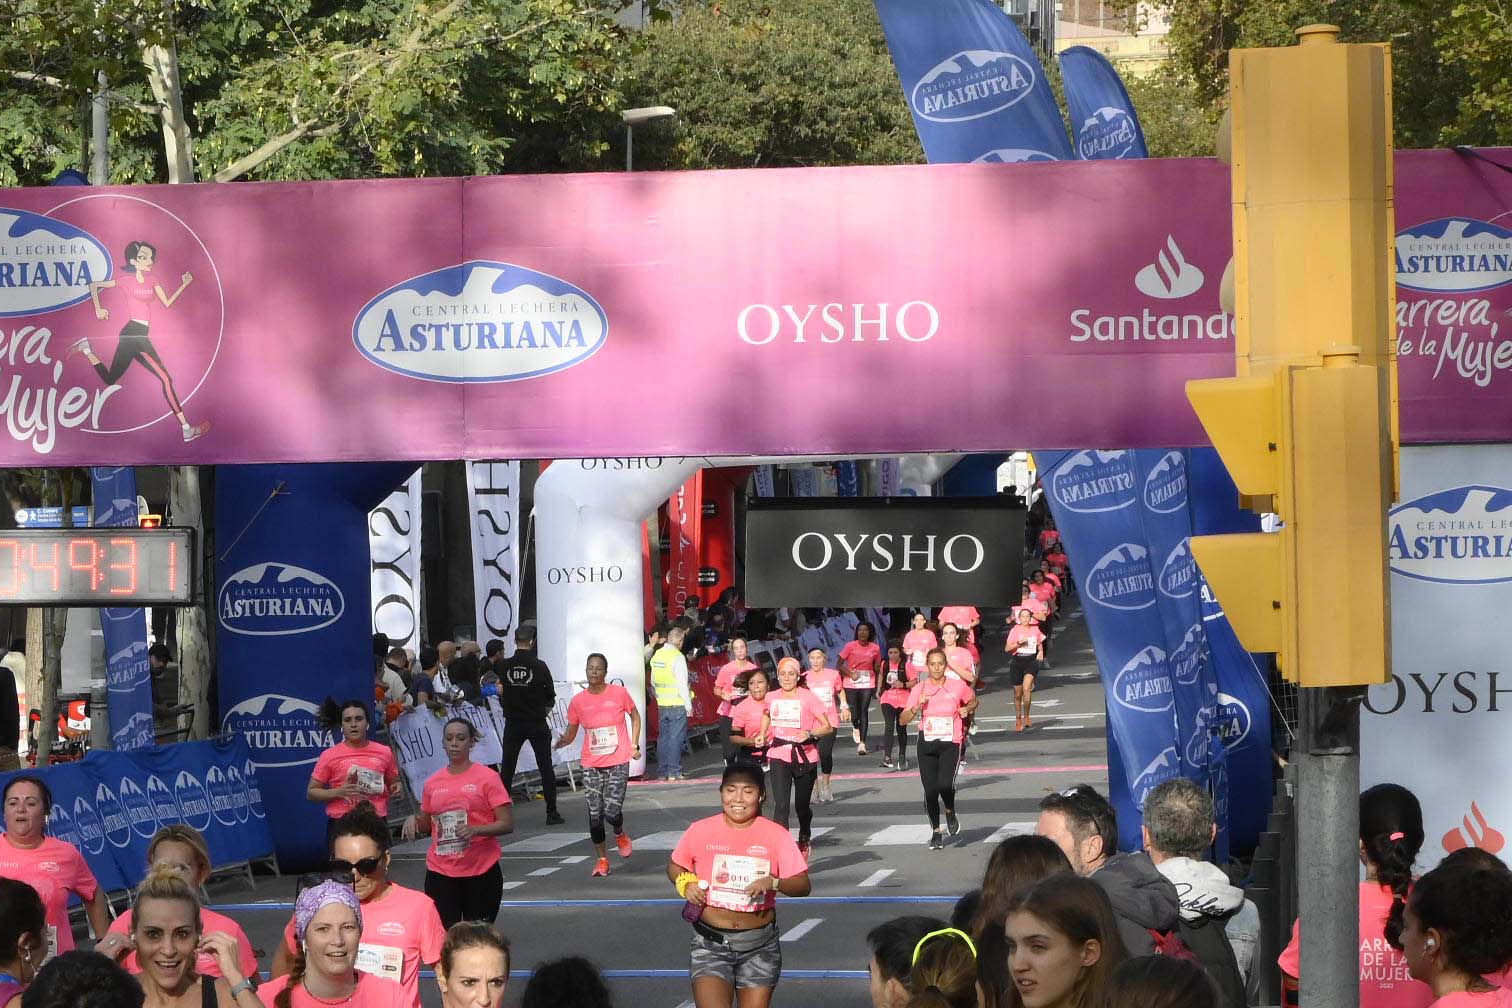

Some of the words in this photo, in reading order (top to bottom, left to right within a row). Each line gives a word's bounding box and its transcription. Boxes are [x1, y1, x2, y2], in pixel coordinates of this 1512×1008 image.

[14, 244, 88, 256] LECHERA
[1409, 243, 1462, 252] CENTRAL
[1465, 242, 1512, 251] LECHER
[411, 303, 489, 317] CENTRAL
[495, 300, 579, 316] LECHERA
[1396, 299, 1491, 328] arrera
[372, 308, 588, 353] ASTURIANA
[736, 300, 939, 345] OYSHO
[1069, 308, 1237, 342] Santand
[1419, 328, 1437, 356] la
[1432, 322, 1512, 387] Muje
[581, 457, 663, 471] OYSHO
[1416, 520, 1484, 531] CENTRAL
[791, 531, 985, 574] OYSHO
[1389, 523, 1512, 561] ASTURI
[547, 565, 623, 586] OYSHO
[234, 588, 277, 596] CENTRAL
[222, 592, 336, 620] ASTURIANA
[513, 671, 527, 680] BP
[1363, 671, 1512, 716] OYSH
[236, 720, 278, 728] CENTRAL
[1364, 952, 1384, 966] DE
[1360, 967, 1413, 982] MUJER
